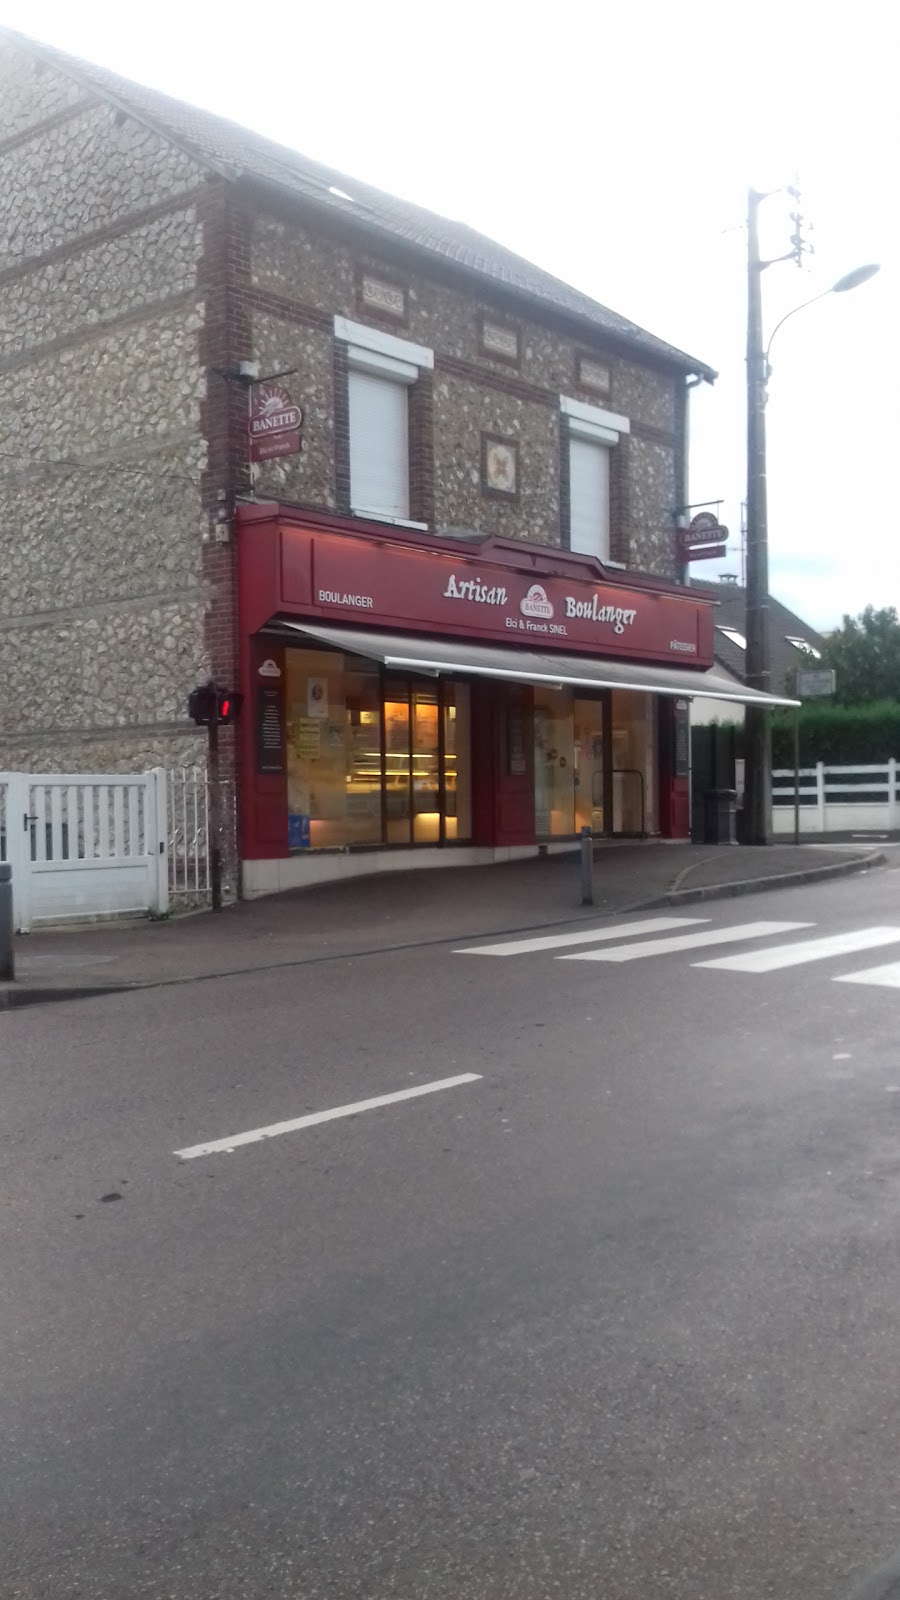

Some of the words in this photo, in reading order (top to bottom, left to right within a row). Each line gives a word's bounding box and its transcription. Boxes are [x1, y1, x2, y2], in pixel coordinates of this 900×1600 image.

[253, 412, 296, 431] BANETTE
[319, 590, 373, 608] BOULANGER
[444, 575, 508, 605] Artisan
[565, 593, 637, 634] Boulanger
[519, 619, 525, 630] &
[526, 620, 549, 632] Franck
